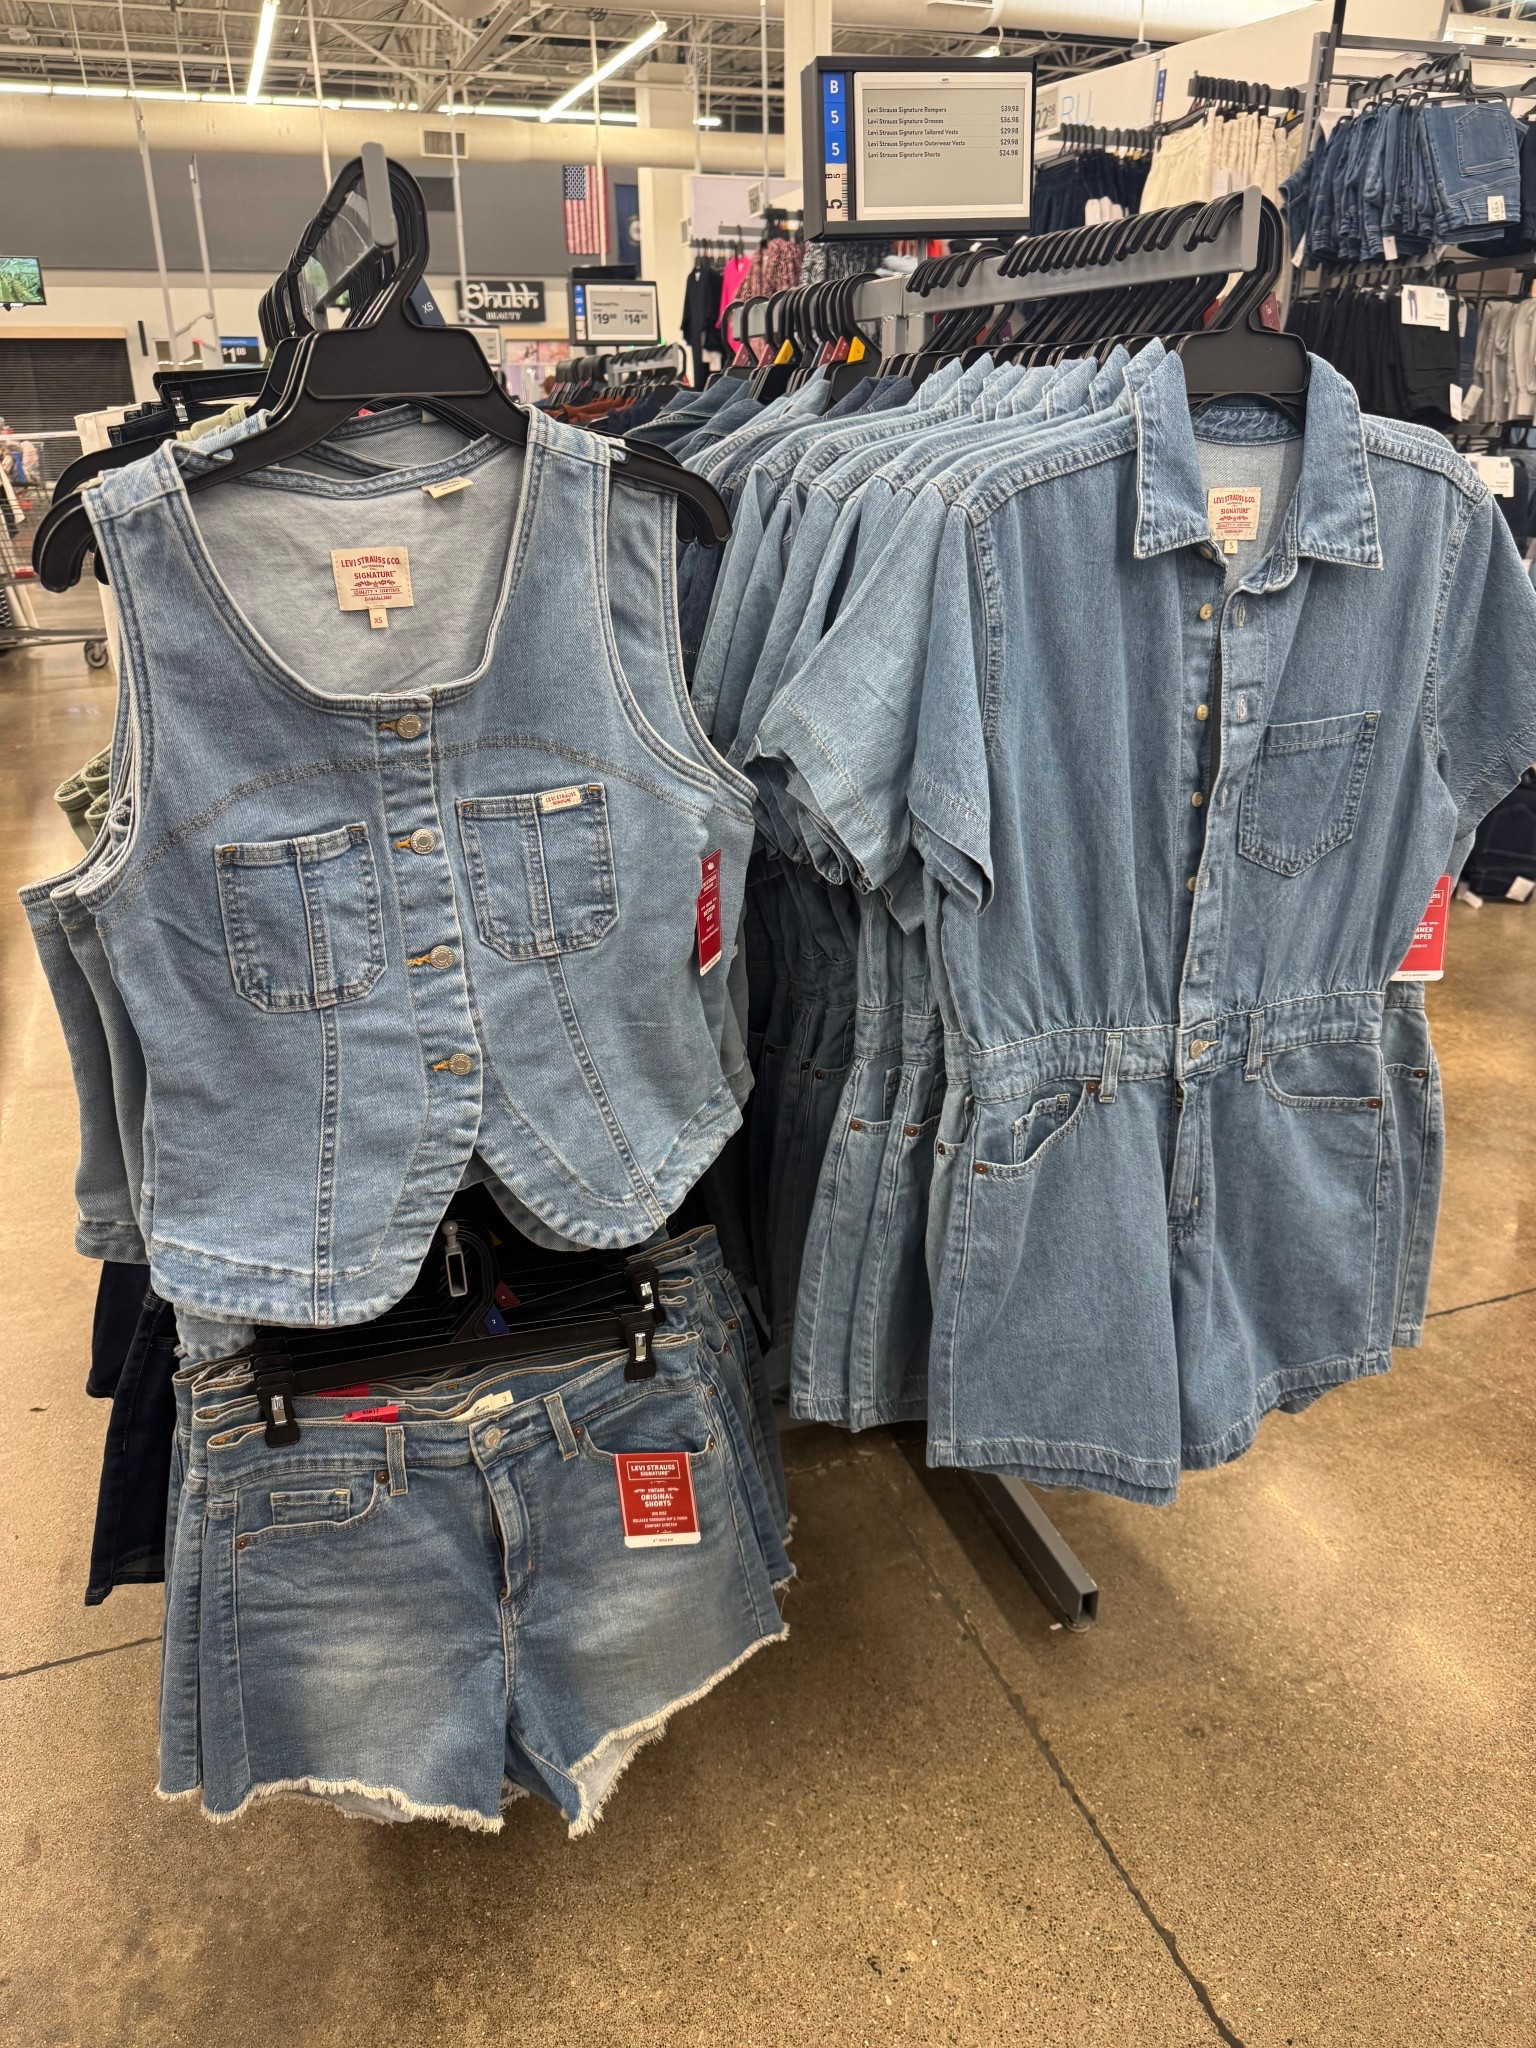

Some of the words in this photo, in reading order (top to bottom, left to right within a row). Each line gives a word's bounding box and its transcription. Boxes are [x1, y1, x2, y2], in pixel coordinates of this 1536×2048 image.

[830, 80, 839, 93] B
[831, 110, 839, 124] 5
[832, 142, 840, 156] 5
[465, 282, 539, 310] Shubh
[422, 301, 434, 314] XS
[486, 311, 522, 320] BEAUTY
[1225, 494, 1244, 502] STRAUSS
[341, 559, 356, 568] LEVI
[357, 555, 386, 566] STRAUSS
[641, 1493, 674, 1501] ORIGINAL
[645, 1500, 672, 1508] SHORTS
